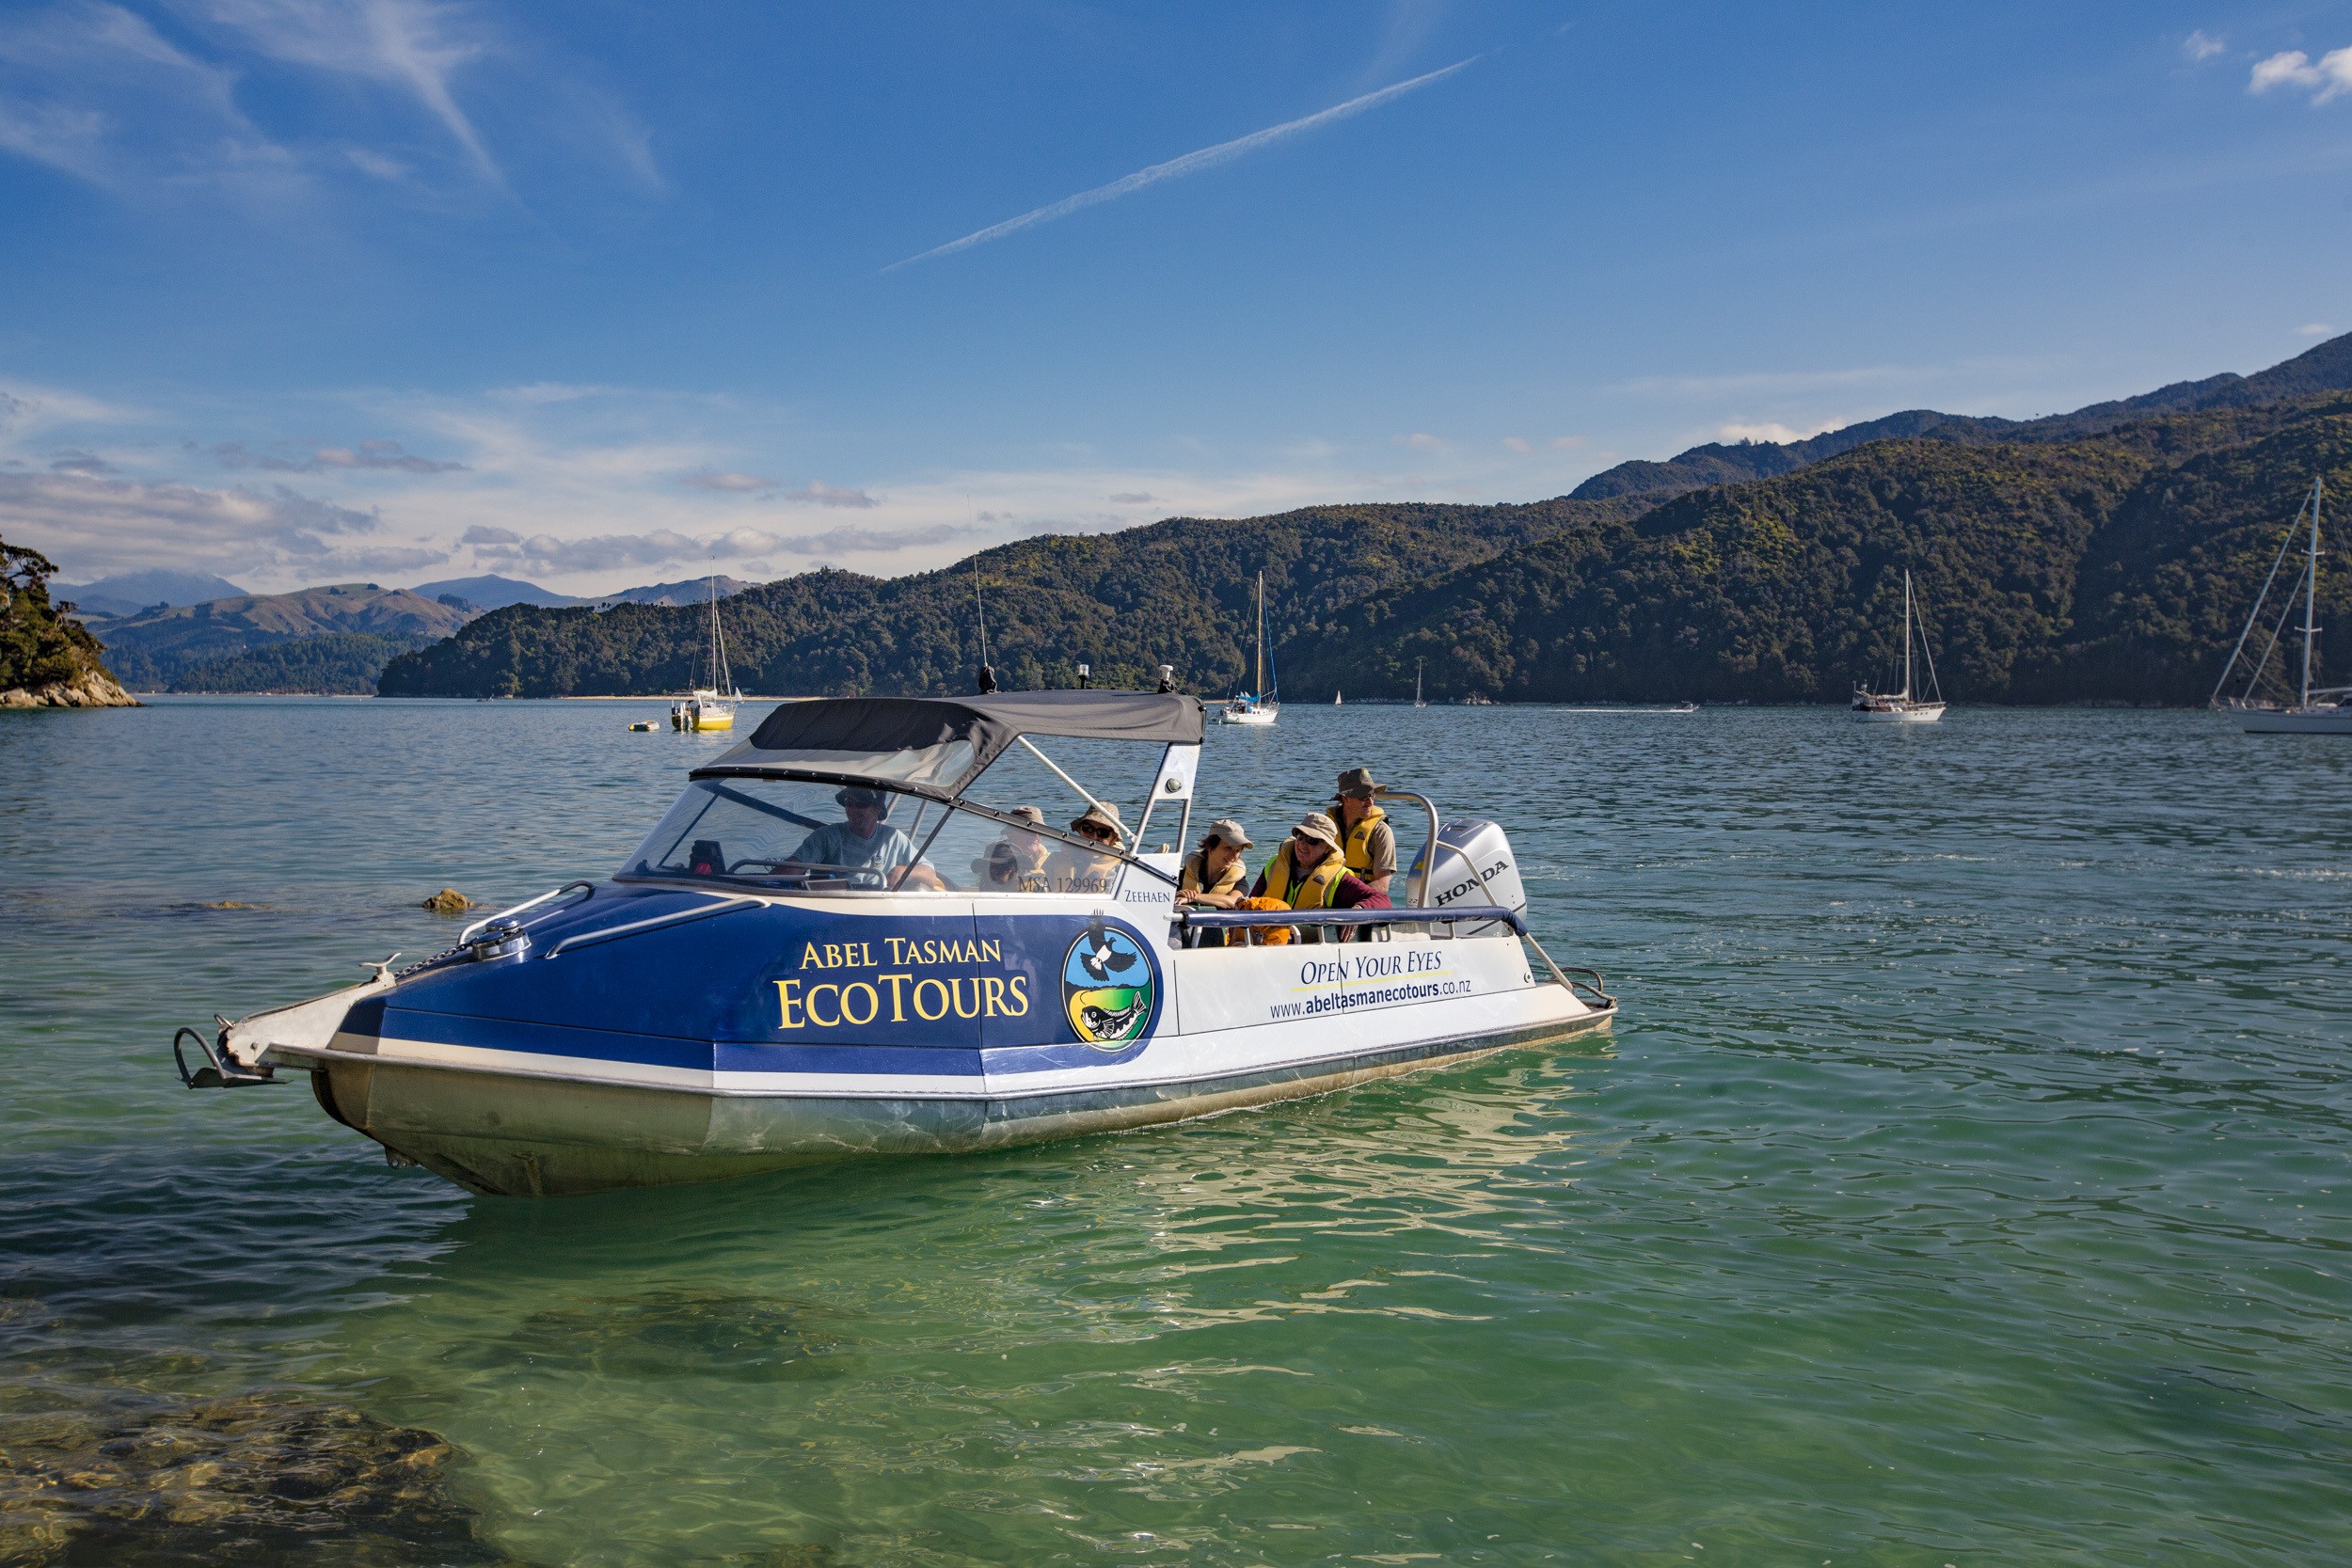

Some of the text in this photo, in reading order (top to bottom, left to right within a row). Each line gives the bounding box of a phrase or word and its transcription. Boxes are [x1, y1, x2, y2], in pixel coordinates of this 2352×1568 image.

[1017, 876, 1107, 893] MSA 129969
[1124, 889, 1170, 903] ZEEHAEN
[1435, 861, 1509, 907] HONDA
[800, 937, 1001, 970] ABEL TASMAN
[1300, 950, 1442, 985] OPEN YOUR EYES
[772, 974, 1029, 1029] ECOTOURS
[1270, 978, 1471, 1019] www.abeltasmanecotours.co.nz
